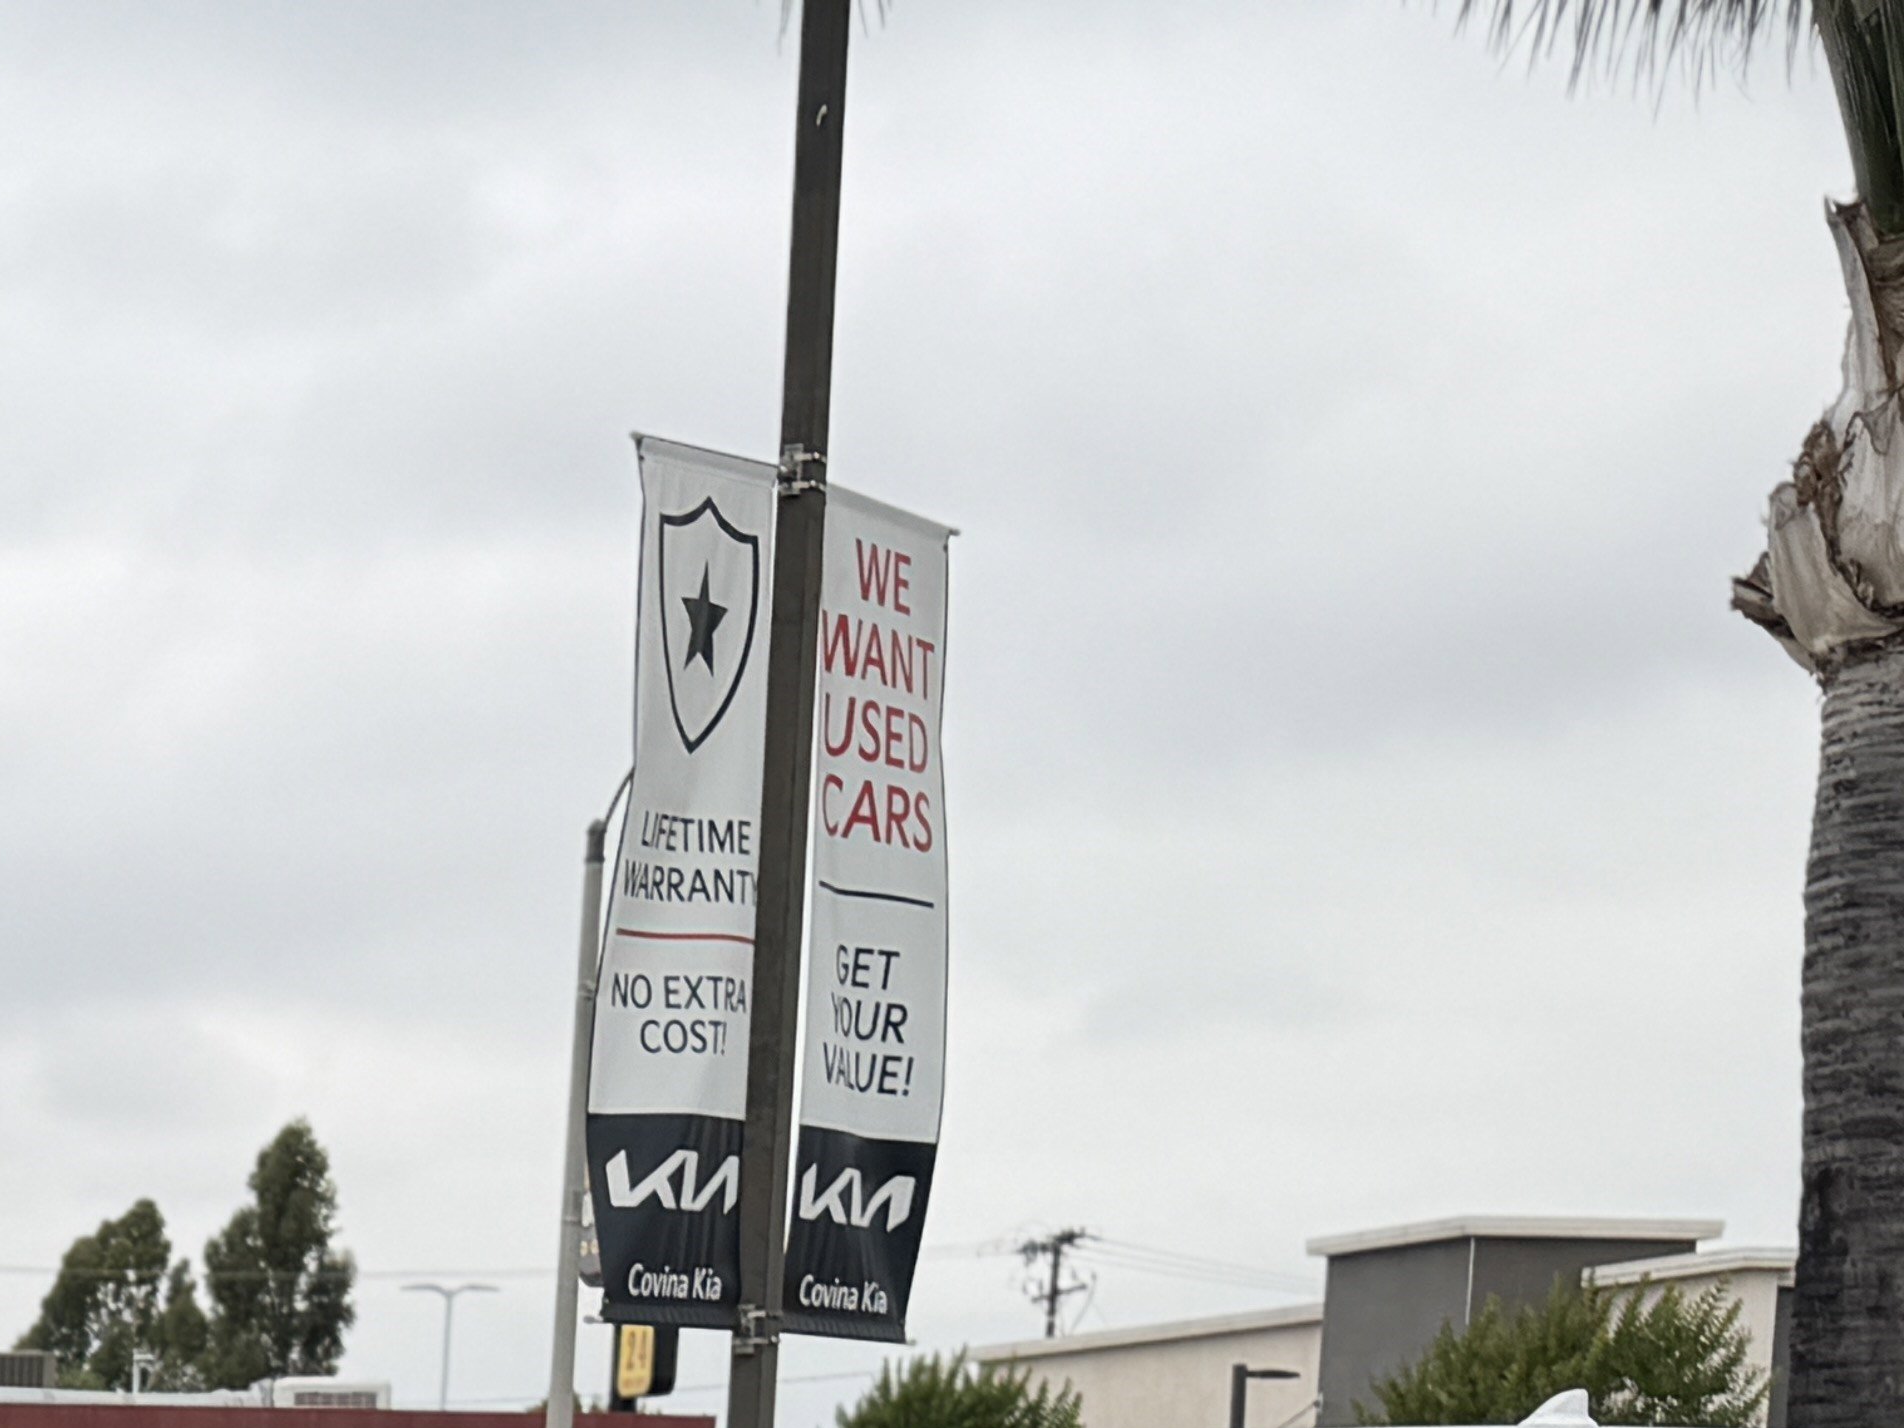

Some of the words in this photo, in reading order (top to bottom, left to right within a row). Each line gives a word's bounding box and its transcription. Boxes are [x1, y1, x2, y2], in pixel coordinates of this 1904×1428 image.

[855, 538, 912, 616] WE
[822, 609, 935, 700] WANT
[824, 692, 928, 774] USED
[641, 810, 752, 856] LIFETIME
[822, 773, 933, 854] CARS
[611, 972, 653, 1009] NO
[664, 974, 747, 1013] EXTRA
[836, 944, 900, 991] GET
[639, 1018, 727, 1056] COST!
[831, 992, 909, 1045] YOUR
[822, 1042, 914, 1097] VALUE!
[627, 1263, 688, 1300] Covina
[691, 1266, 722, 1301] Kia
[798, 1274, 858, 1311] Covina
[861, 1280, 889, 1315] Kia
